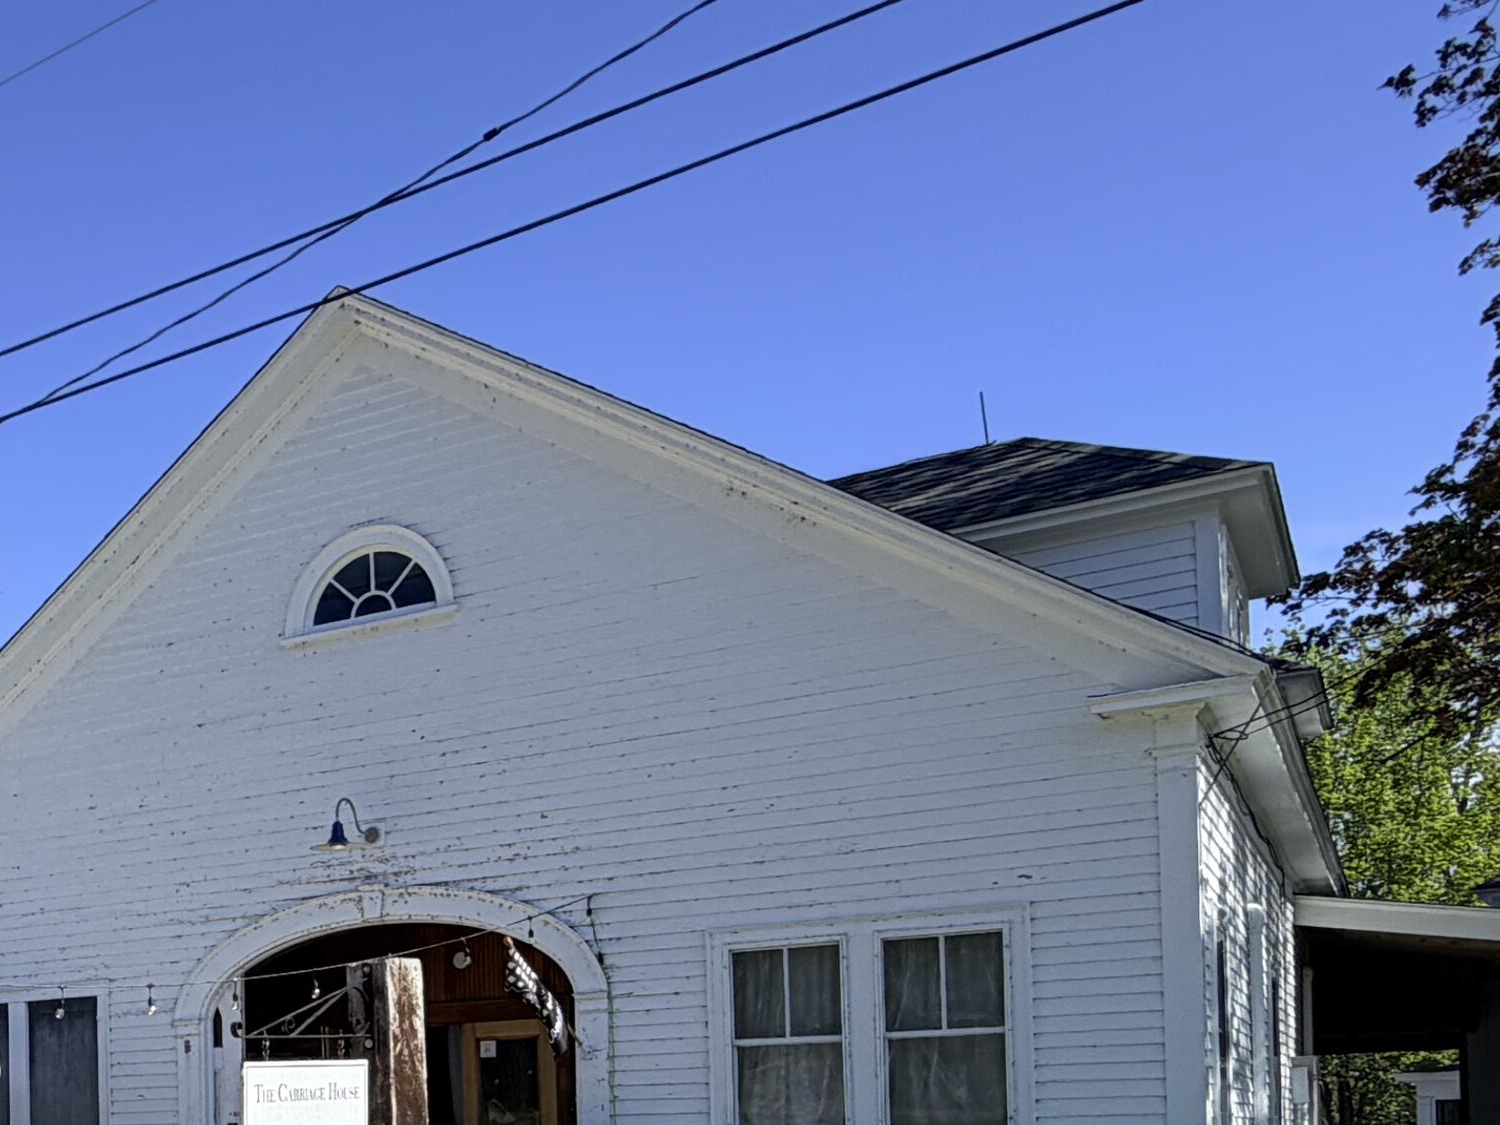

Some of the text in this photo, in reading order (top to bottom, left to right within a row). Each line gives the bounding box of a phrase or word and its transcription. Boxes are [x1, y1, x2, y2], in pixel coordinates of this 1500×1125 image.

[254, 1082, 360, 1103] THE CARRIAGE HOUSE
